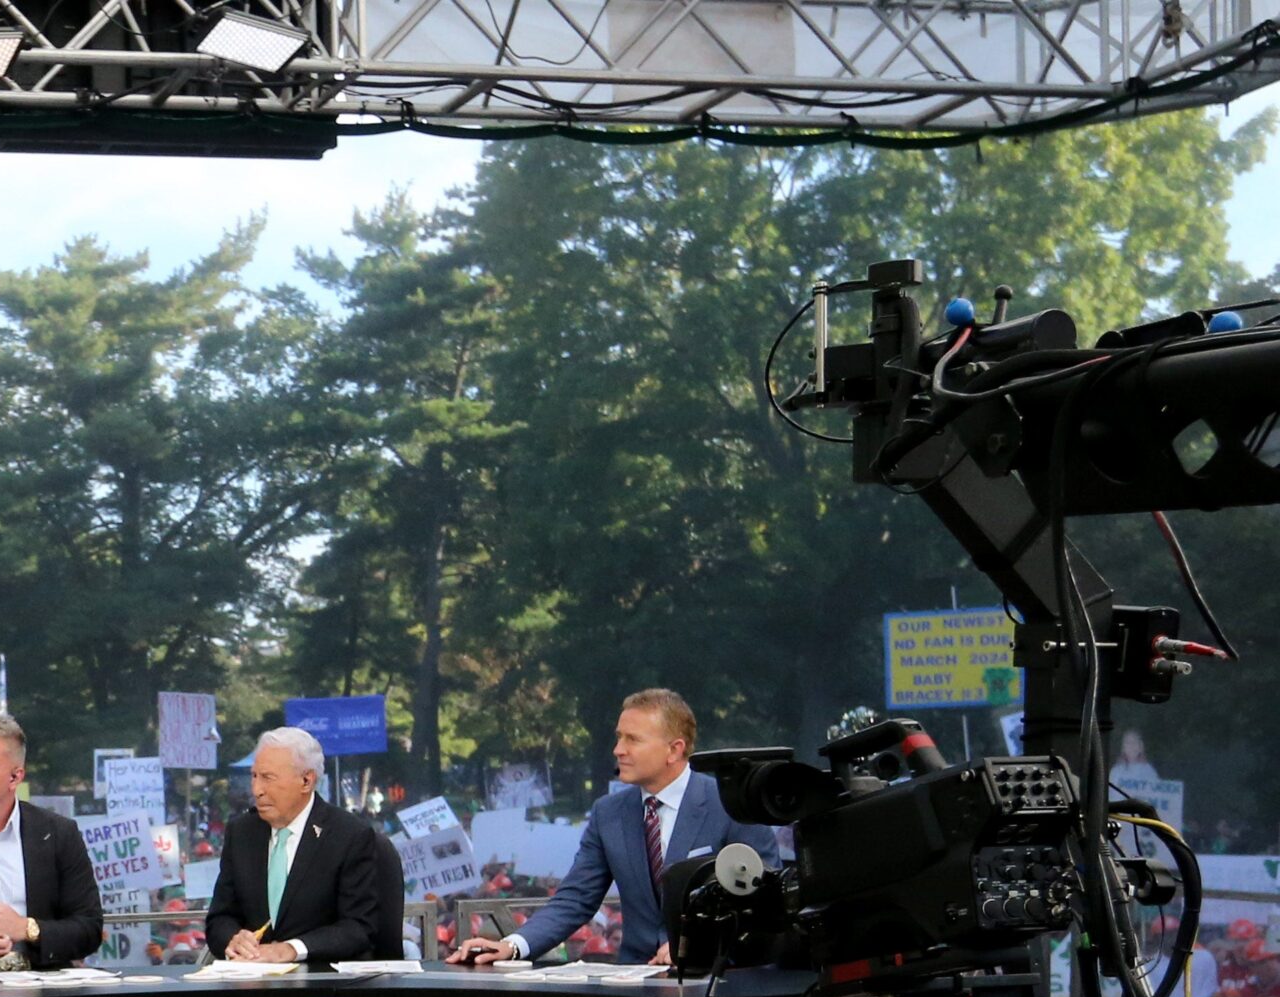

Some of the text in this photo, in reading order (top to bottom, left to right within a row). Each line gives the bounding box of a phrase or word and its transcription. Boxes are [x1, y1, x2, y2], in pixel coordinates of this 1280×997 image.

[898, 615, 1006, 632] OUR NEWEST
[925, 636, 955, 648] FAN
[961, 636, 974, 647] IS
[980, 634, 1009, 646] DUE
[900, 652, 1009, 667] MARCH 2024
[912, 673, 952, 686] BABY
[86, 819, 139, 844] CARTHY
[114, 837, 140, 860] UP
[94, 857, 149, 881] CKEYES
